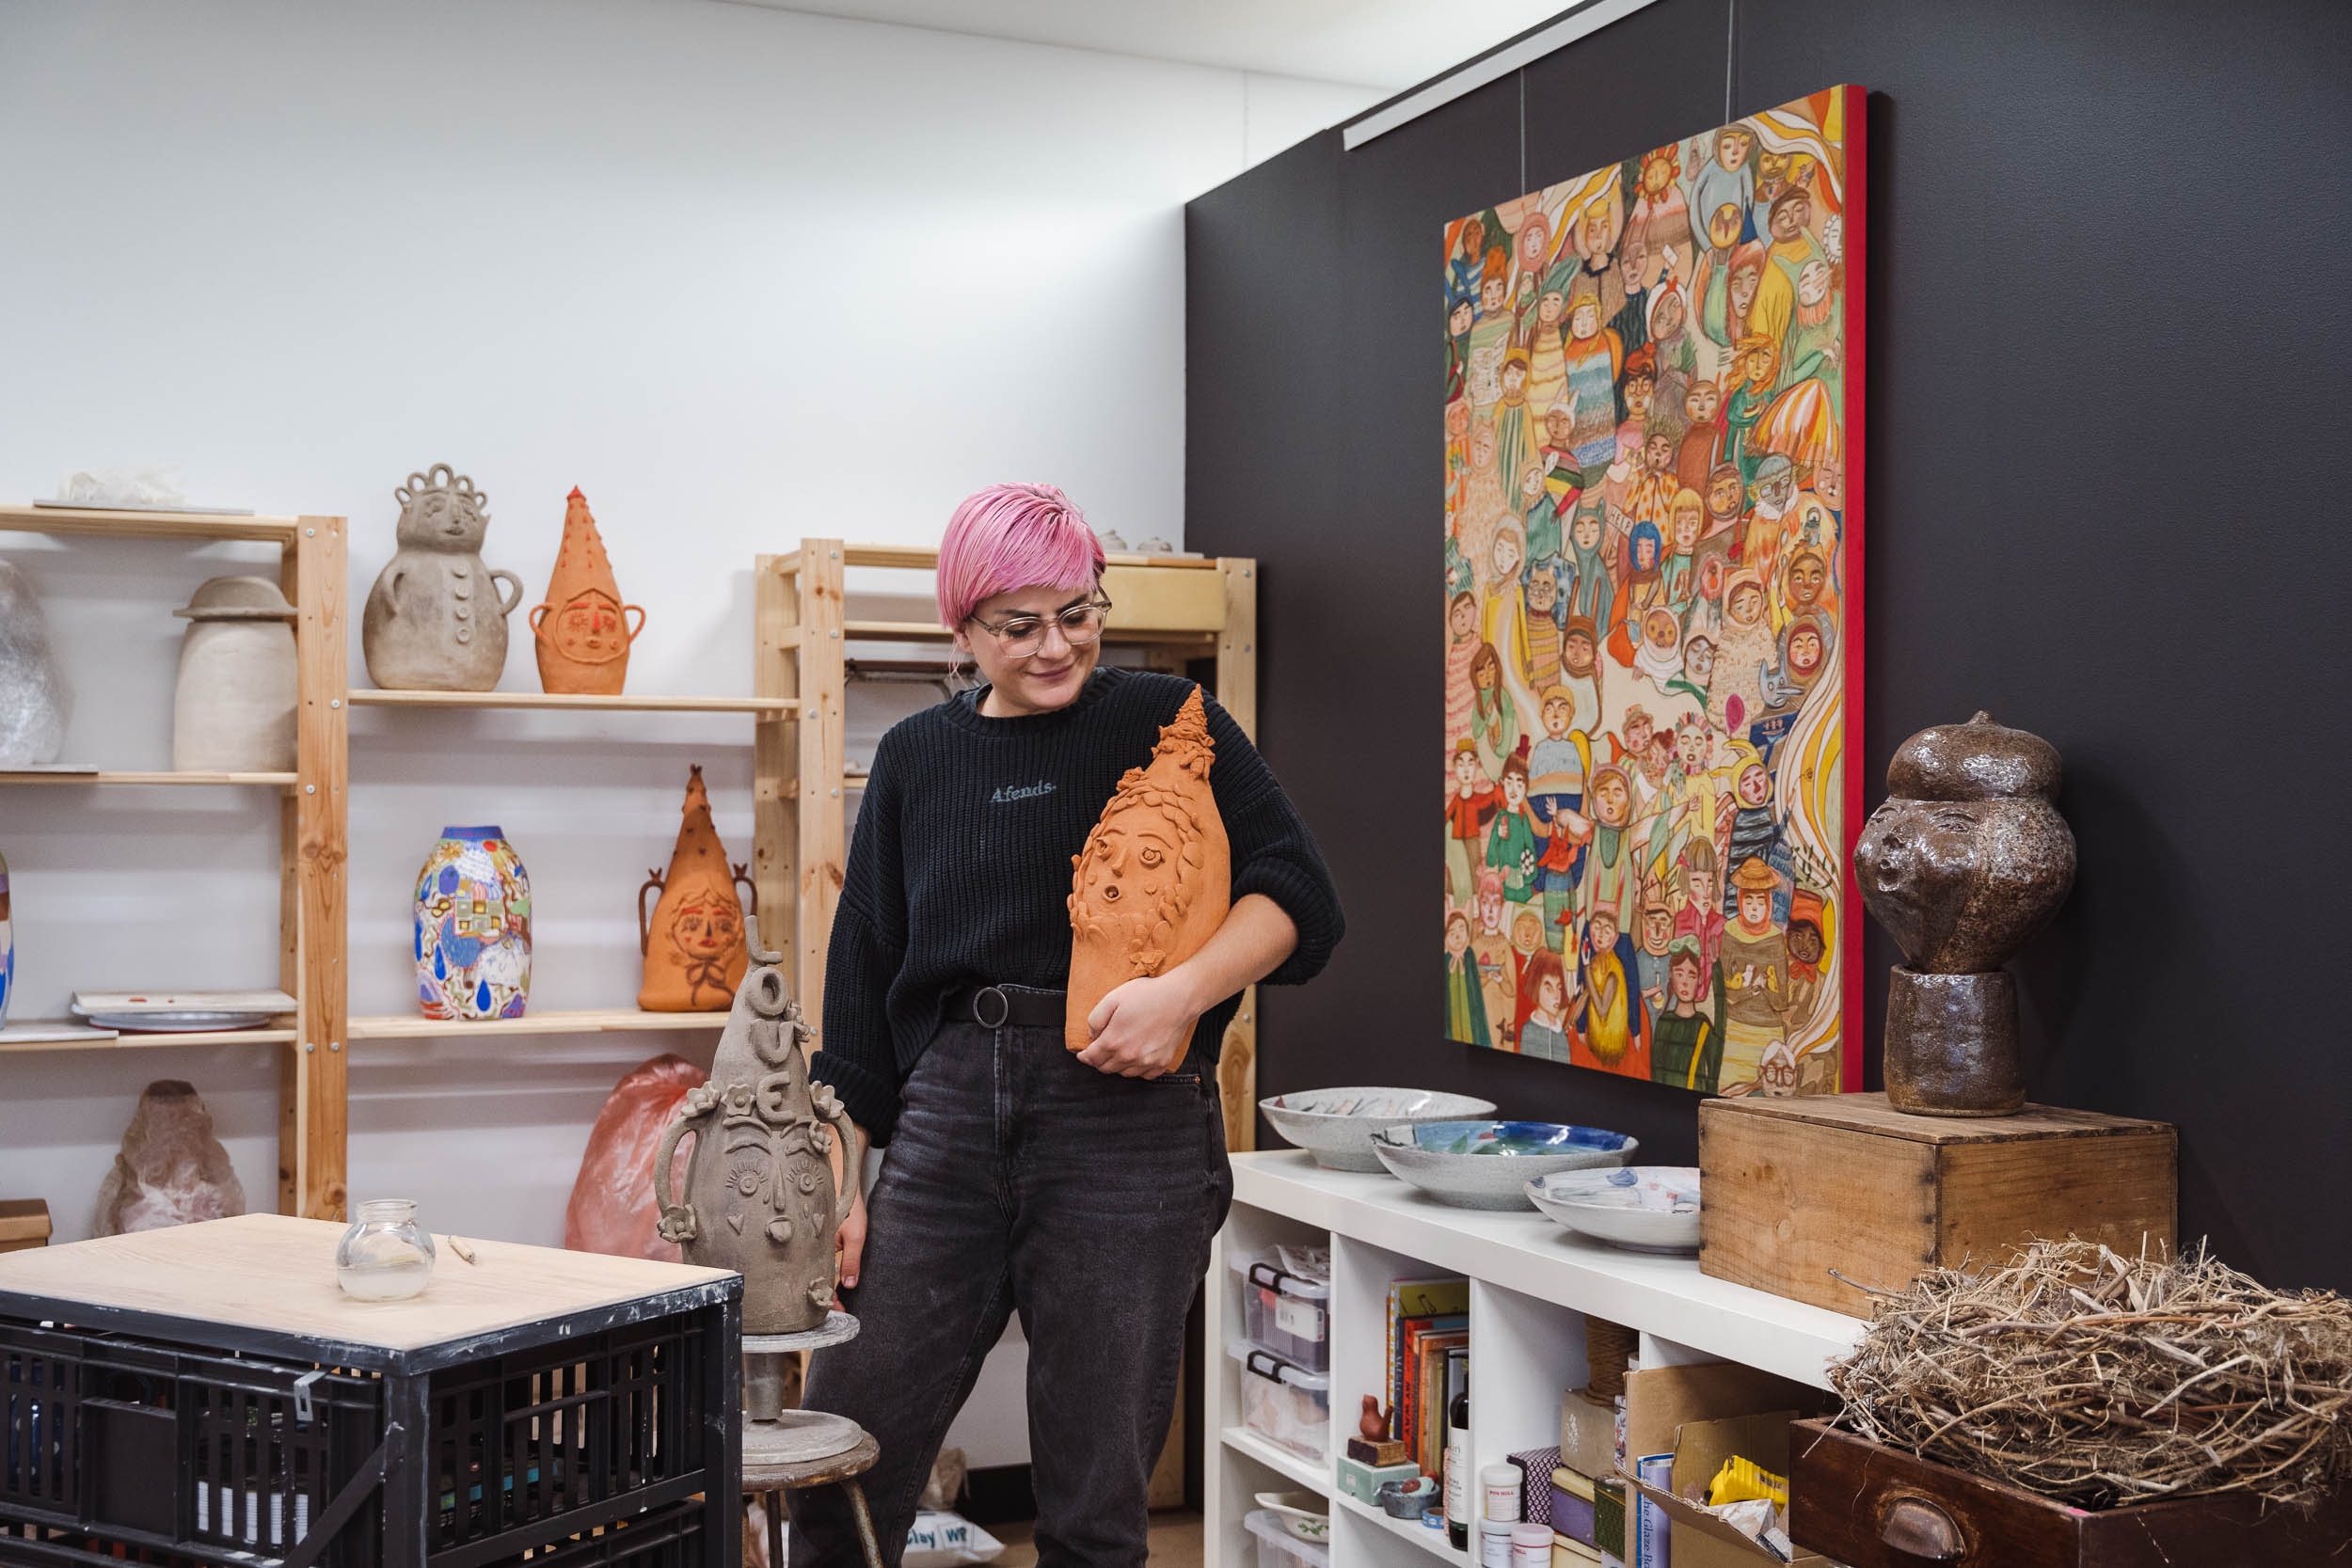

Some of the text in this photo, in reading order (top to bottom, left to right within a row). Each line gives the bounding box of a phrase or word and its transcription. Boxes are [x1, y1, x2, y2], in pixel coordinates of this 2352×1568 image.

[1609, 507, 1630, 531] HELP
[1644, 1501, 1653, 1515] he
[1644, 1519, 1654, 1551] Glaze
